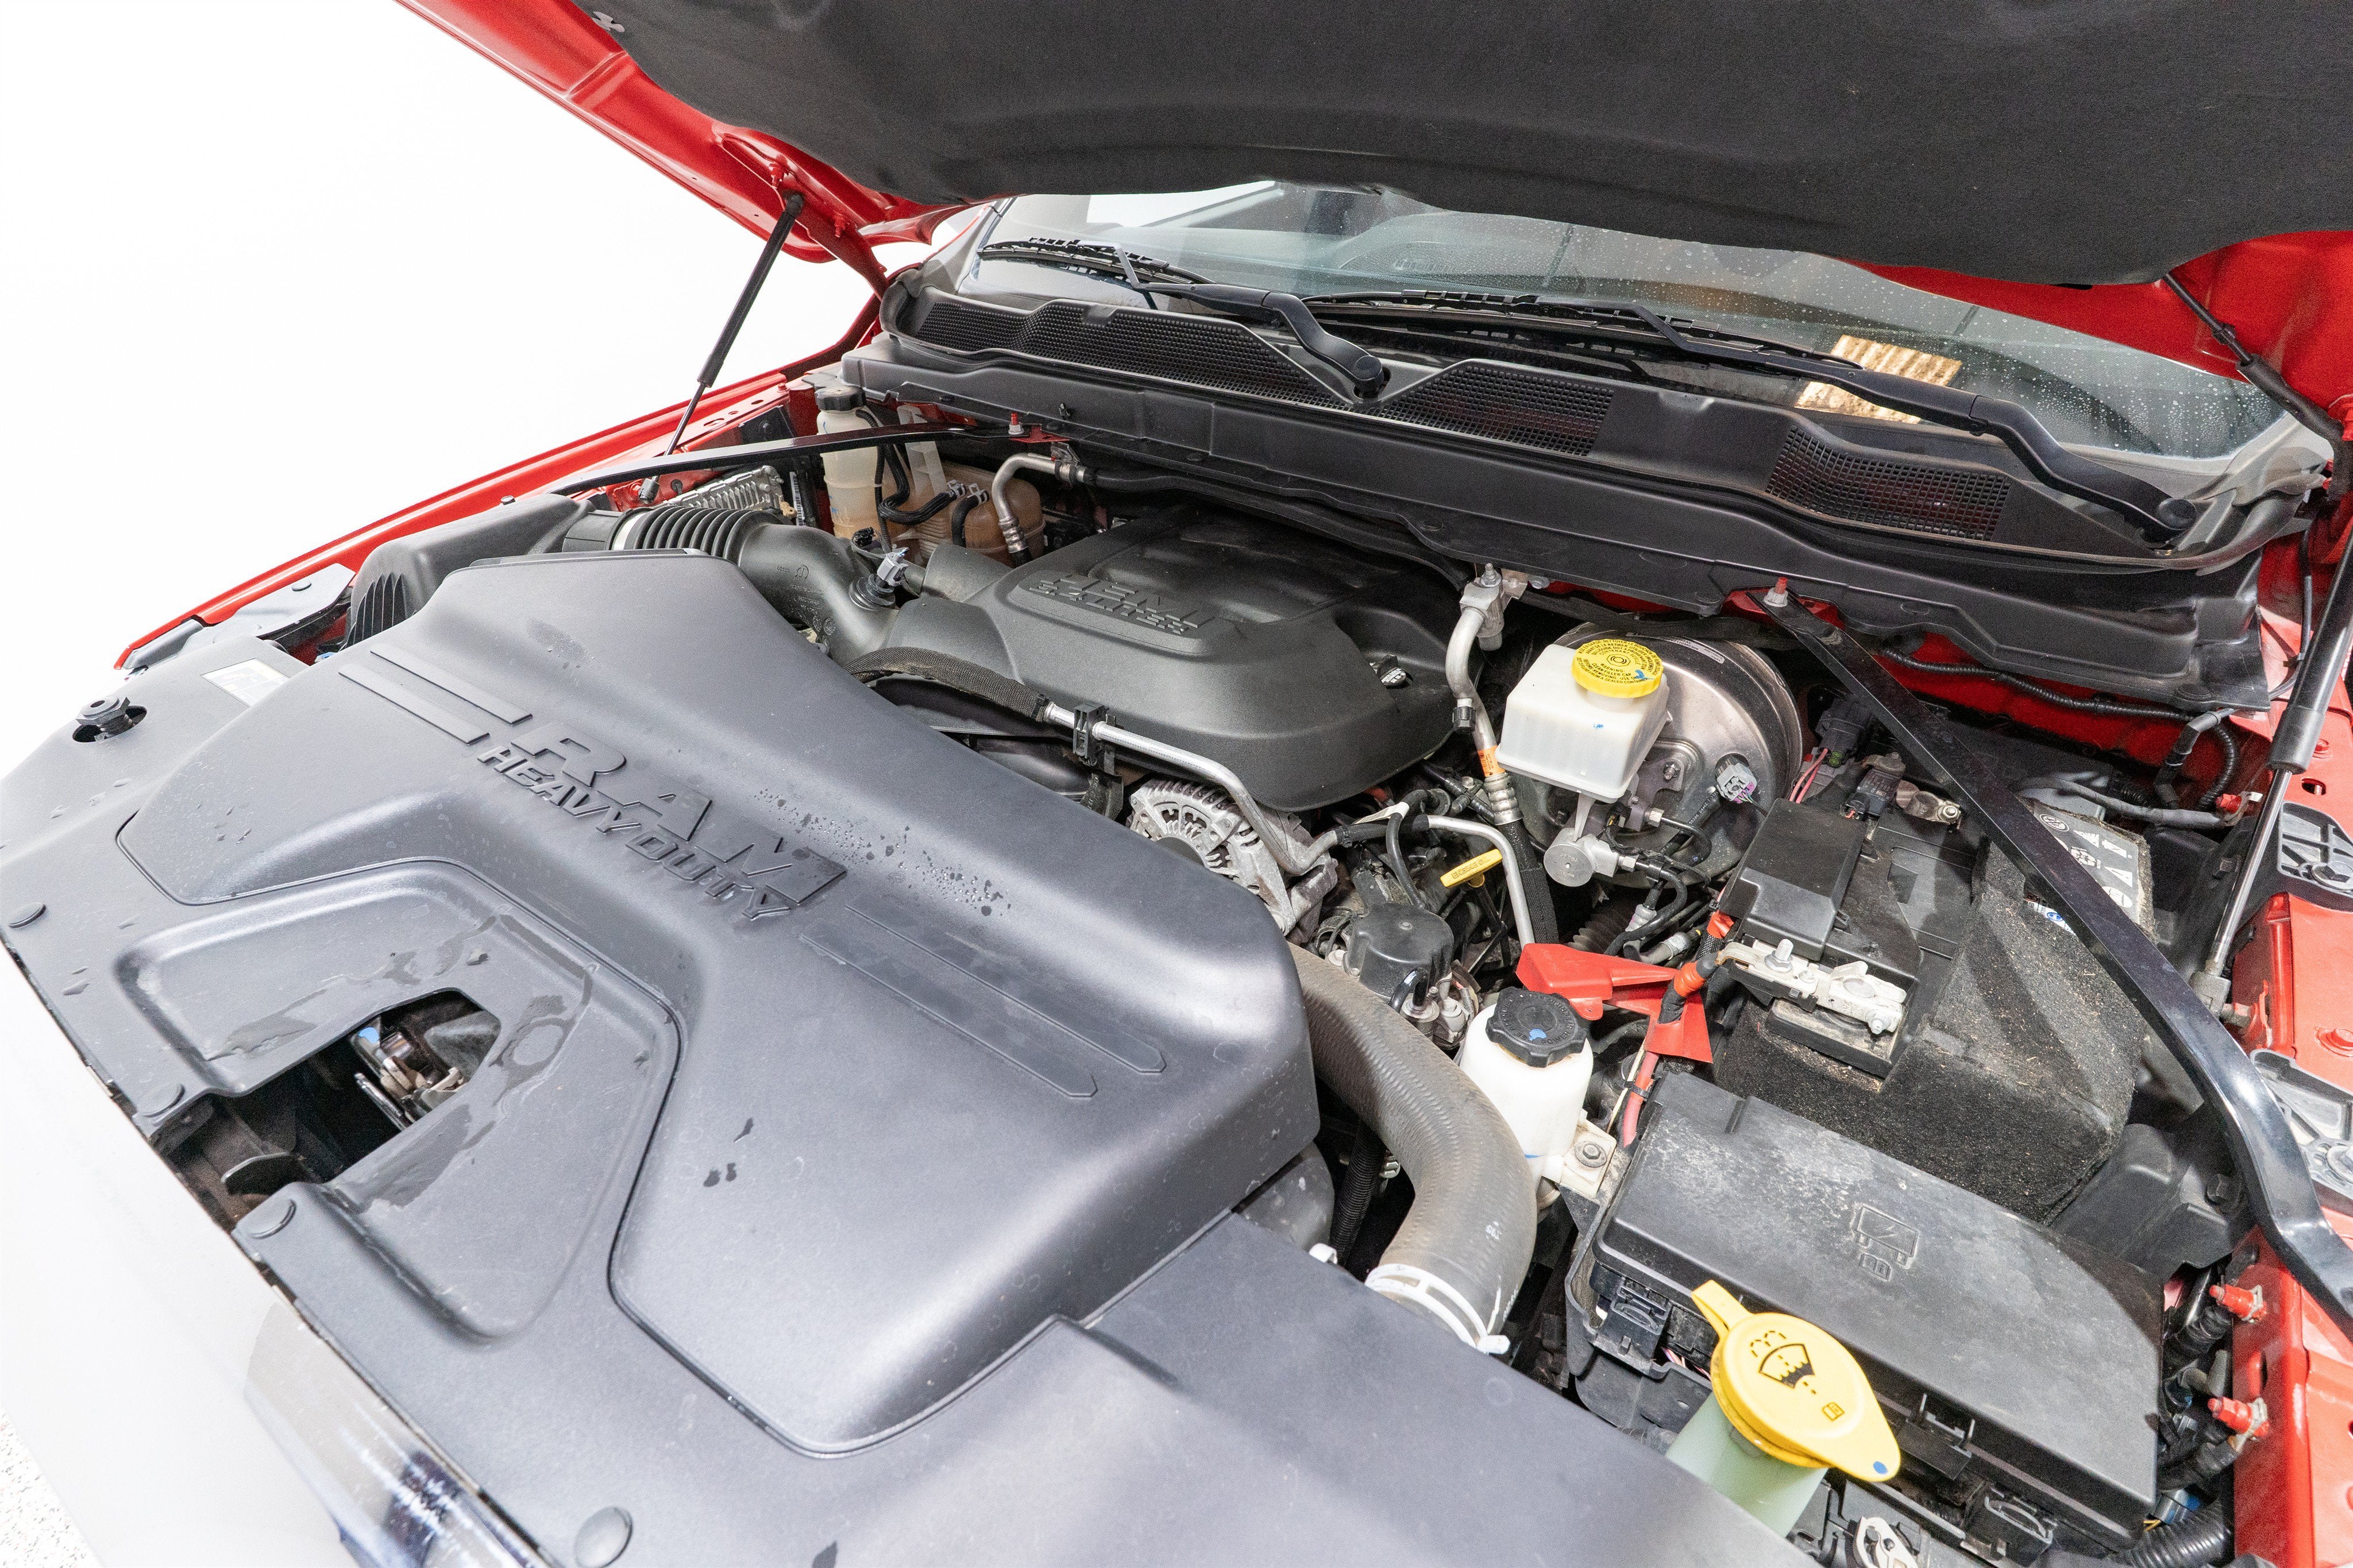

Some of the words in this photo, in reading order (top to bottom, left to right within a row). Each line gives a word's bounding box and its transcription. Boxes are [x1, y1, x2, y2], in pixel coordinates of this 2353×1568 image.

[1592, 663, 1604, 671] CLEAN
[510, 721, 847, 905] RAM
[477, 746, 642, 834] HEAVY
[625, 834, 791, 920] DUTY
[1451, 862, 1478, 879] ENGINE
[1542, 1031, 1571, 1044] POWER
